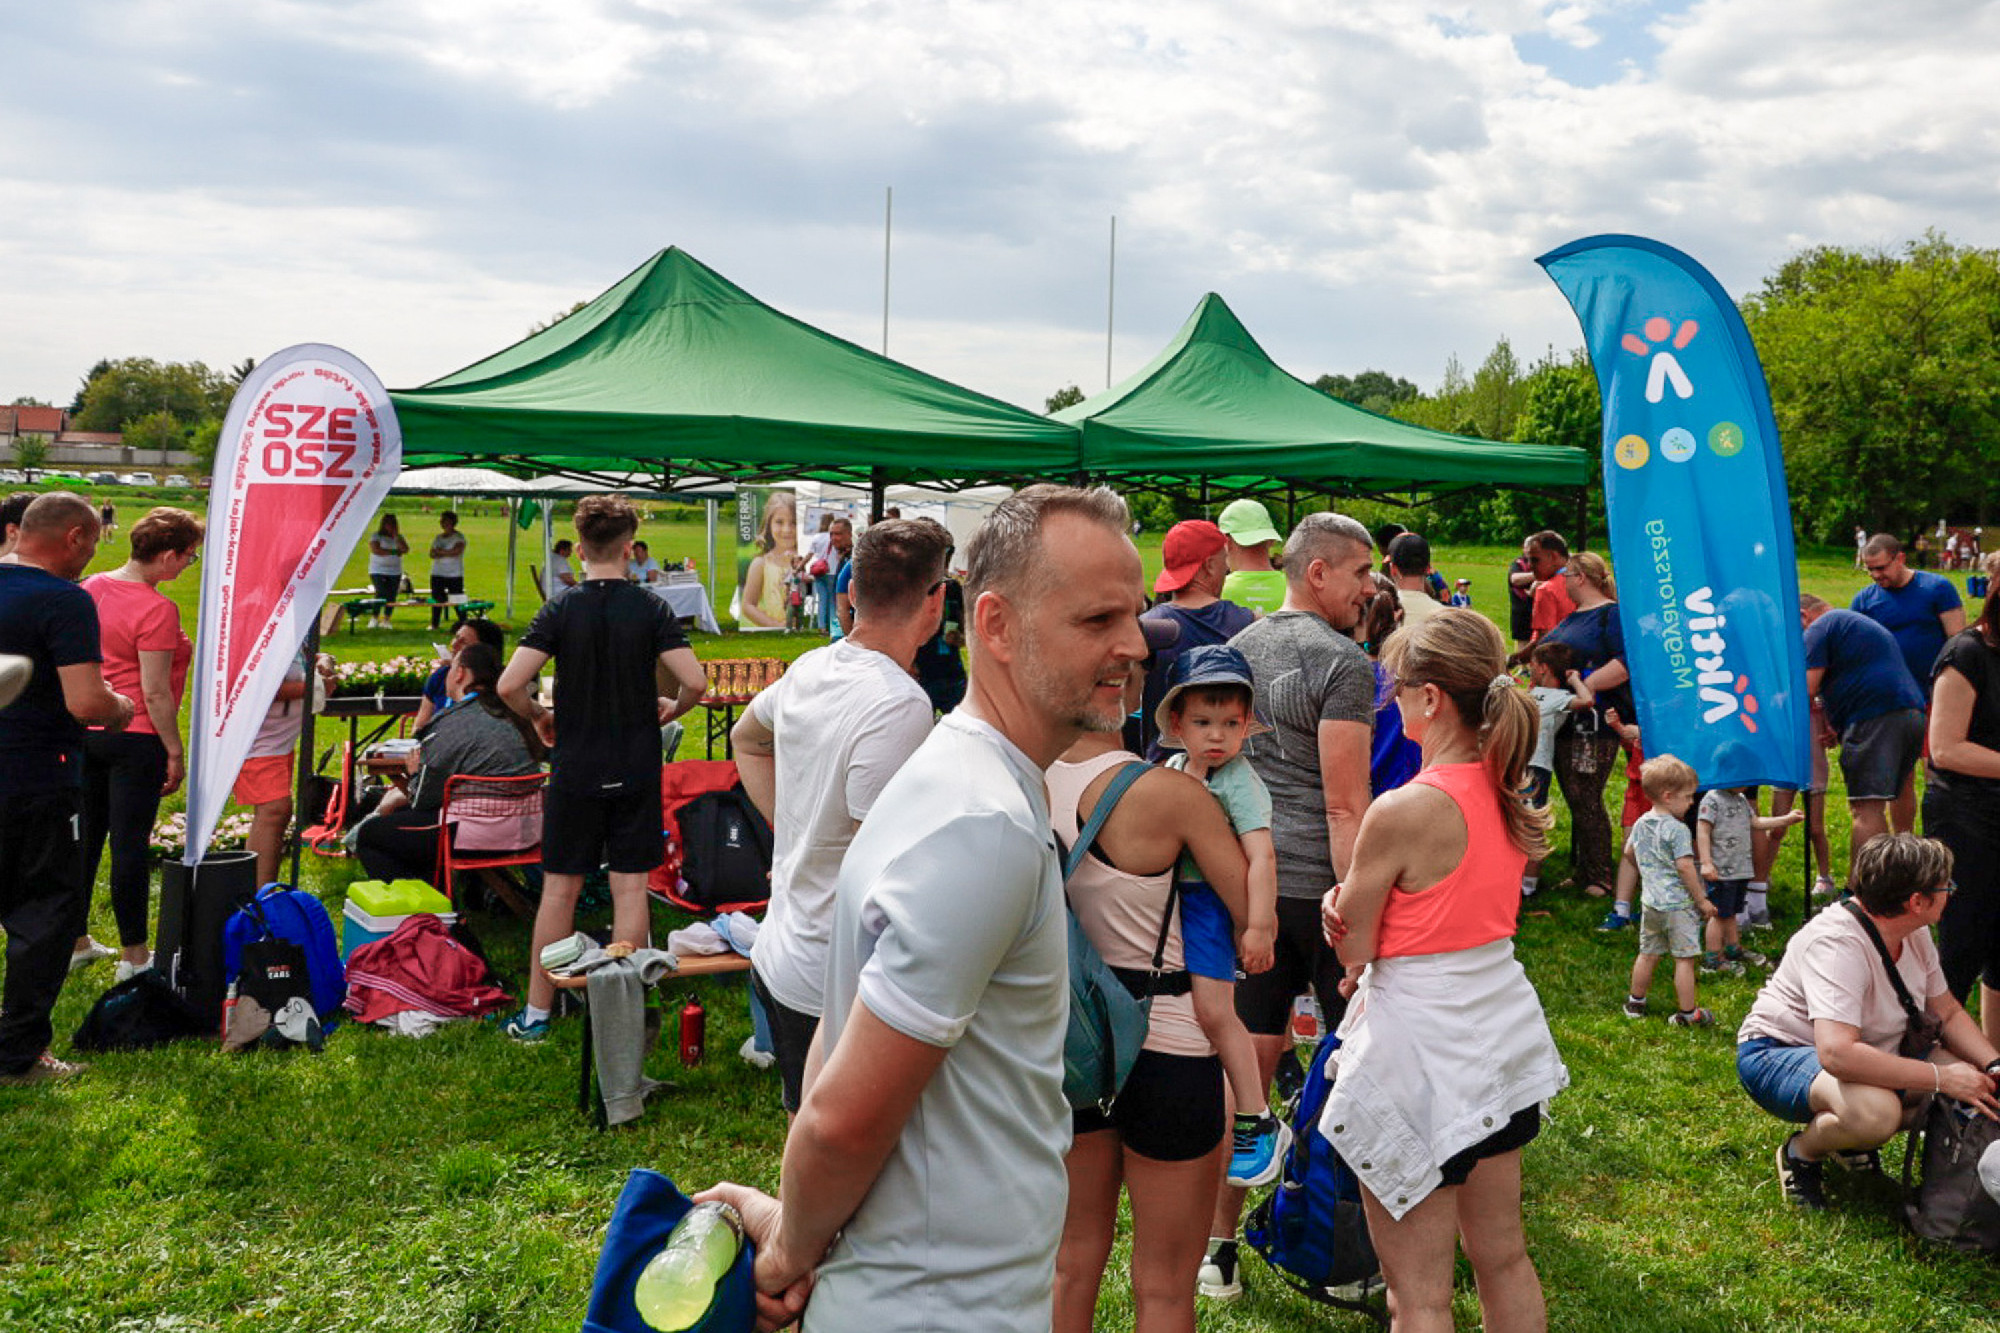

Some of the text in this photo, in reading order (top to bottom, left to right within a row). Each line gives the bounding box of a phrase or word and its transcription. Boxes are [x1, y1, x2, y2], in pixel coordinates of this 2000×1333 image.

[265, 403, 357, 442] SZE
[263, 442, 356, 478] OSZ
[248, 621, 279, 672] aerobik
